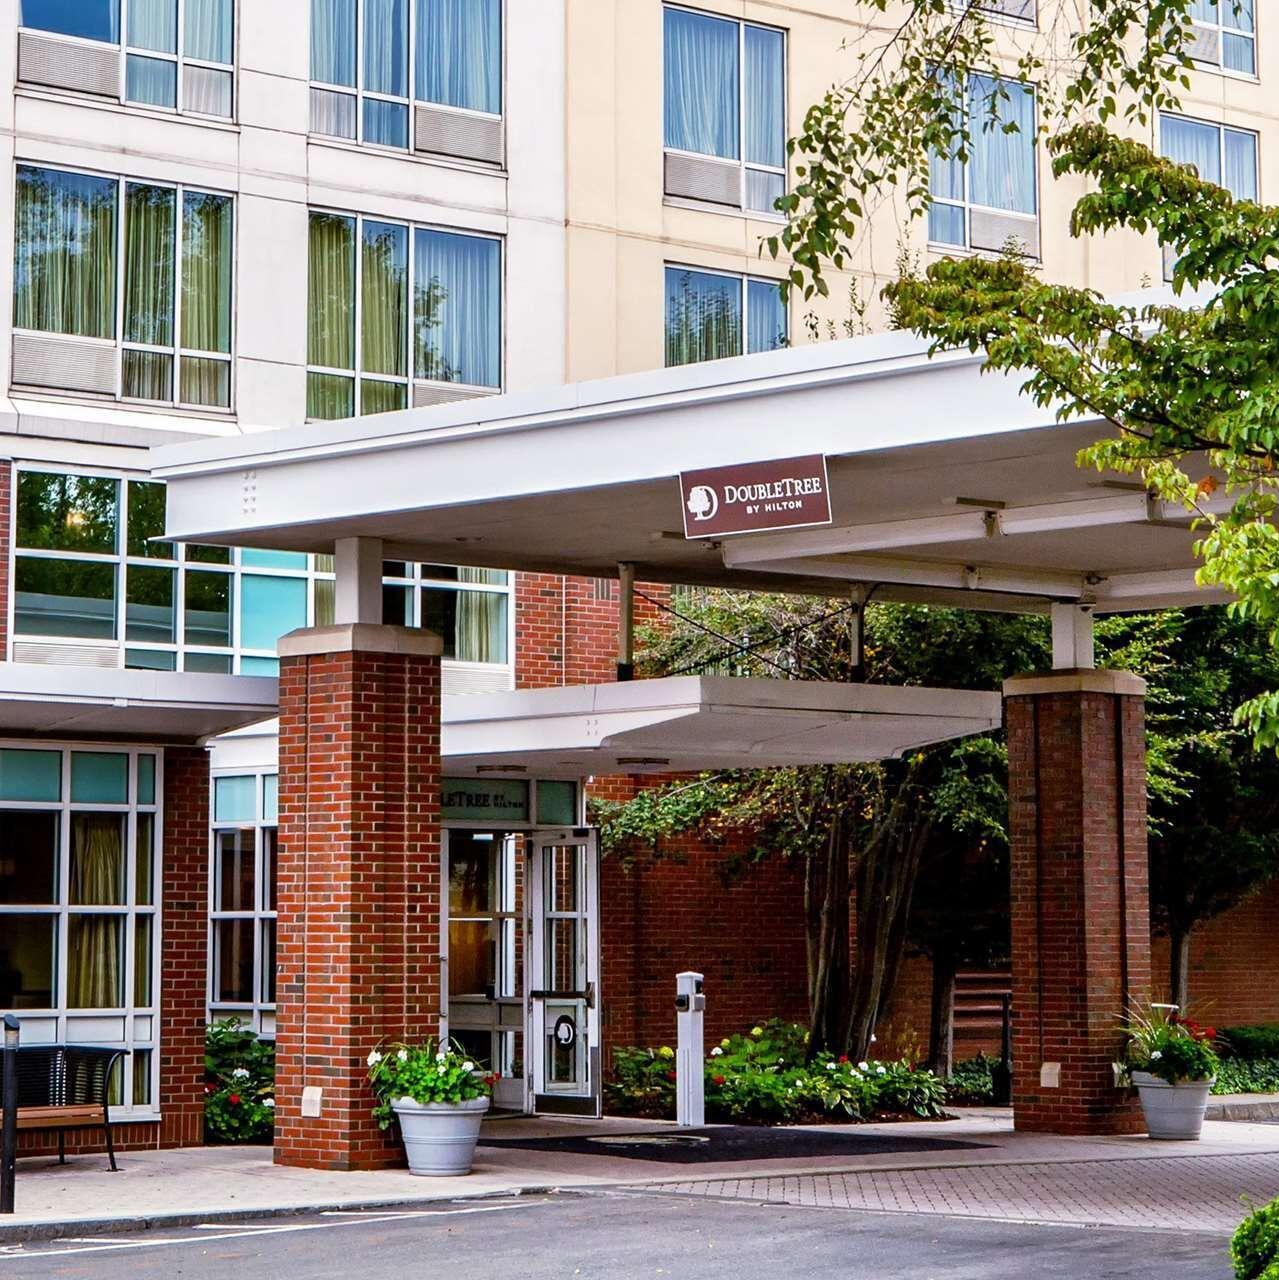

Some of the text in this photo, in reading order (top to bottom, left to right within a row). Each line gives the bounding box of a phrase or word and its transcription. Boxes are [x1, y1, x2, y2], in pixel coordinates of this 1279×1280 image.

[724, 477, 822, 504] DOUBLETREE
[746, 500, 803, 514] BY HILTON
[440, 791, 490, 808] LETREE
